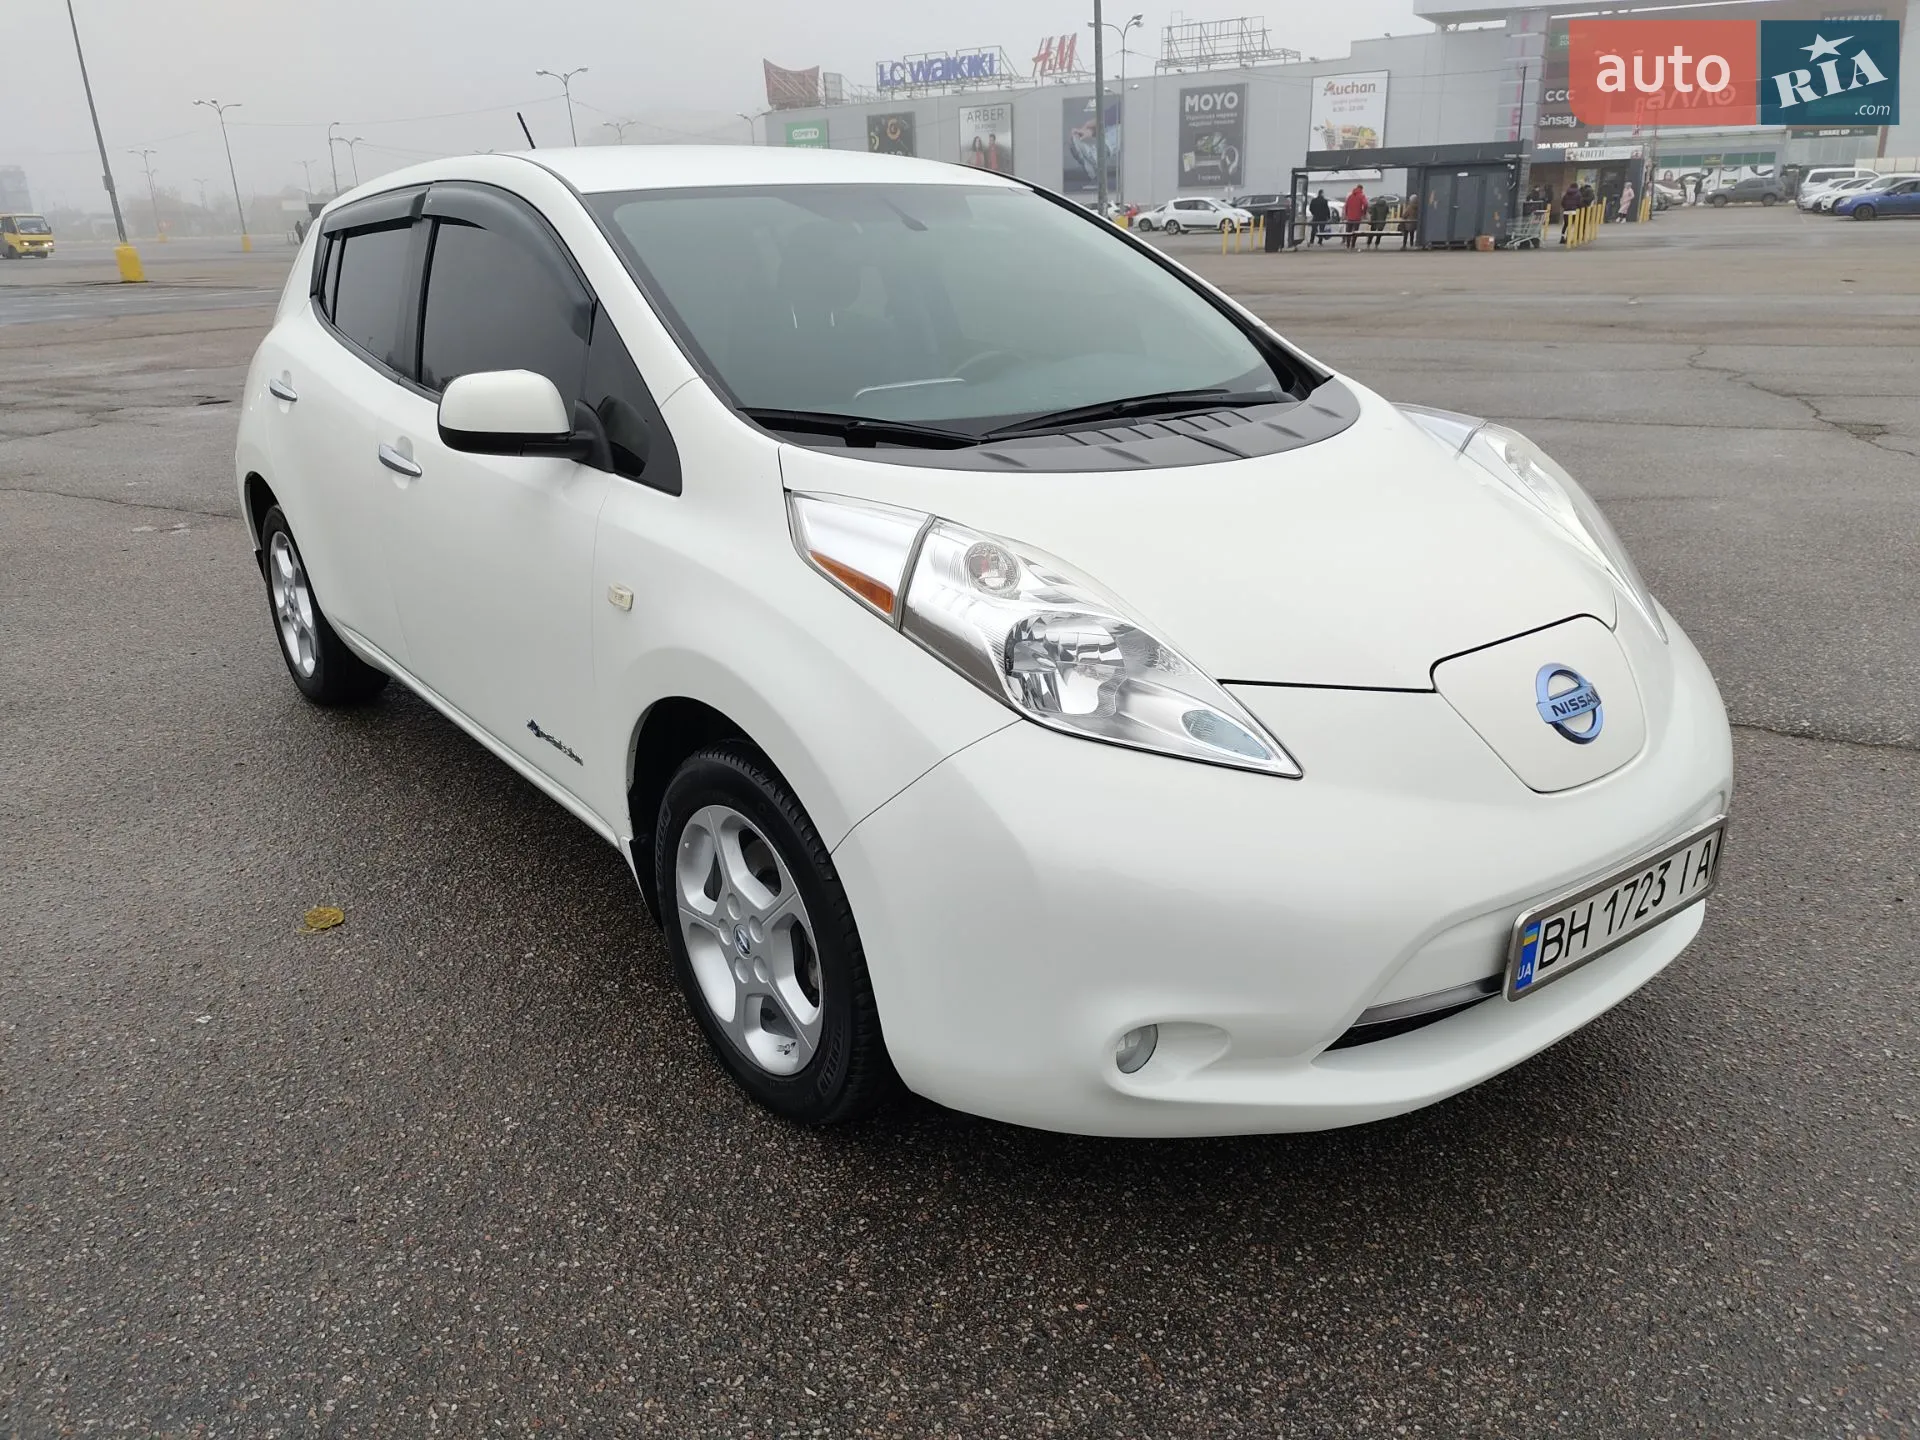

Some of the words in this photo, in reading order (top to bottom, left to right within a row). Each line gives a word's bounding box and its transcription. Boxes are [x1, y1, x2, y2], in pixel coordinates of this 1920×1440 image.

[1324, 81, 1376, 96] Auchan
[1545, 90, 1576, 102] CCC
[1185, 91, 1238, 112] MOYO
[967, 108, 1004, 122] ARBER
[1540, 114, 1577, 128] sinsay
[1551, 690, 1600, 717] NISSAN
[1538, 901, 1594, 972] BH
[1603, 859, 1672, 937] 1723
[1516, 960, 1531, 981] UA
